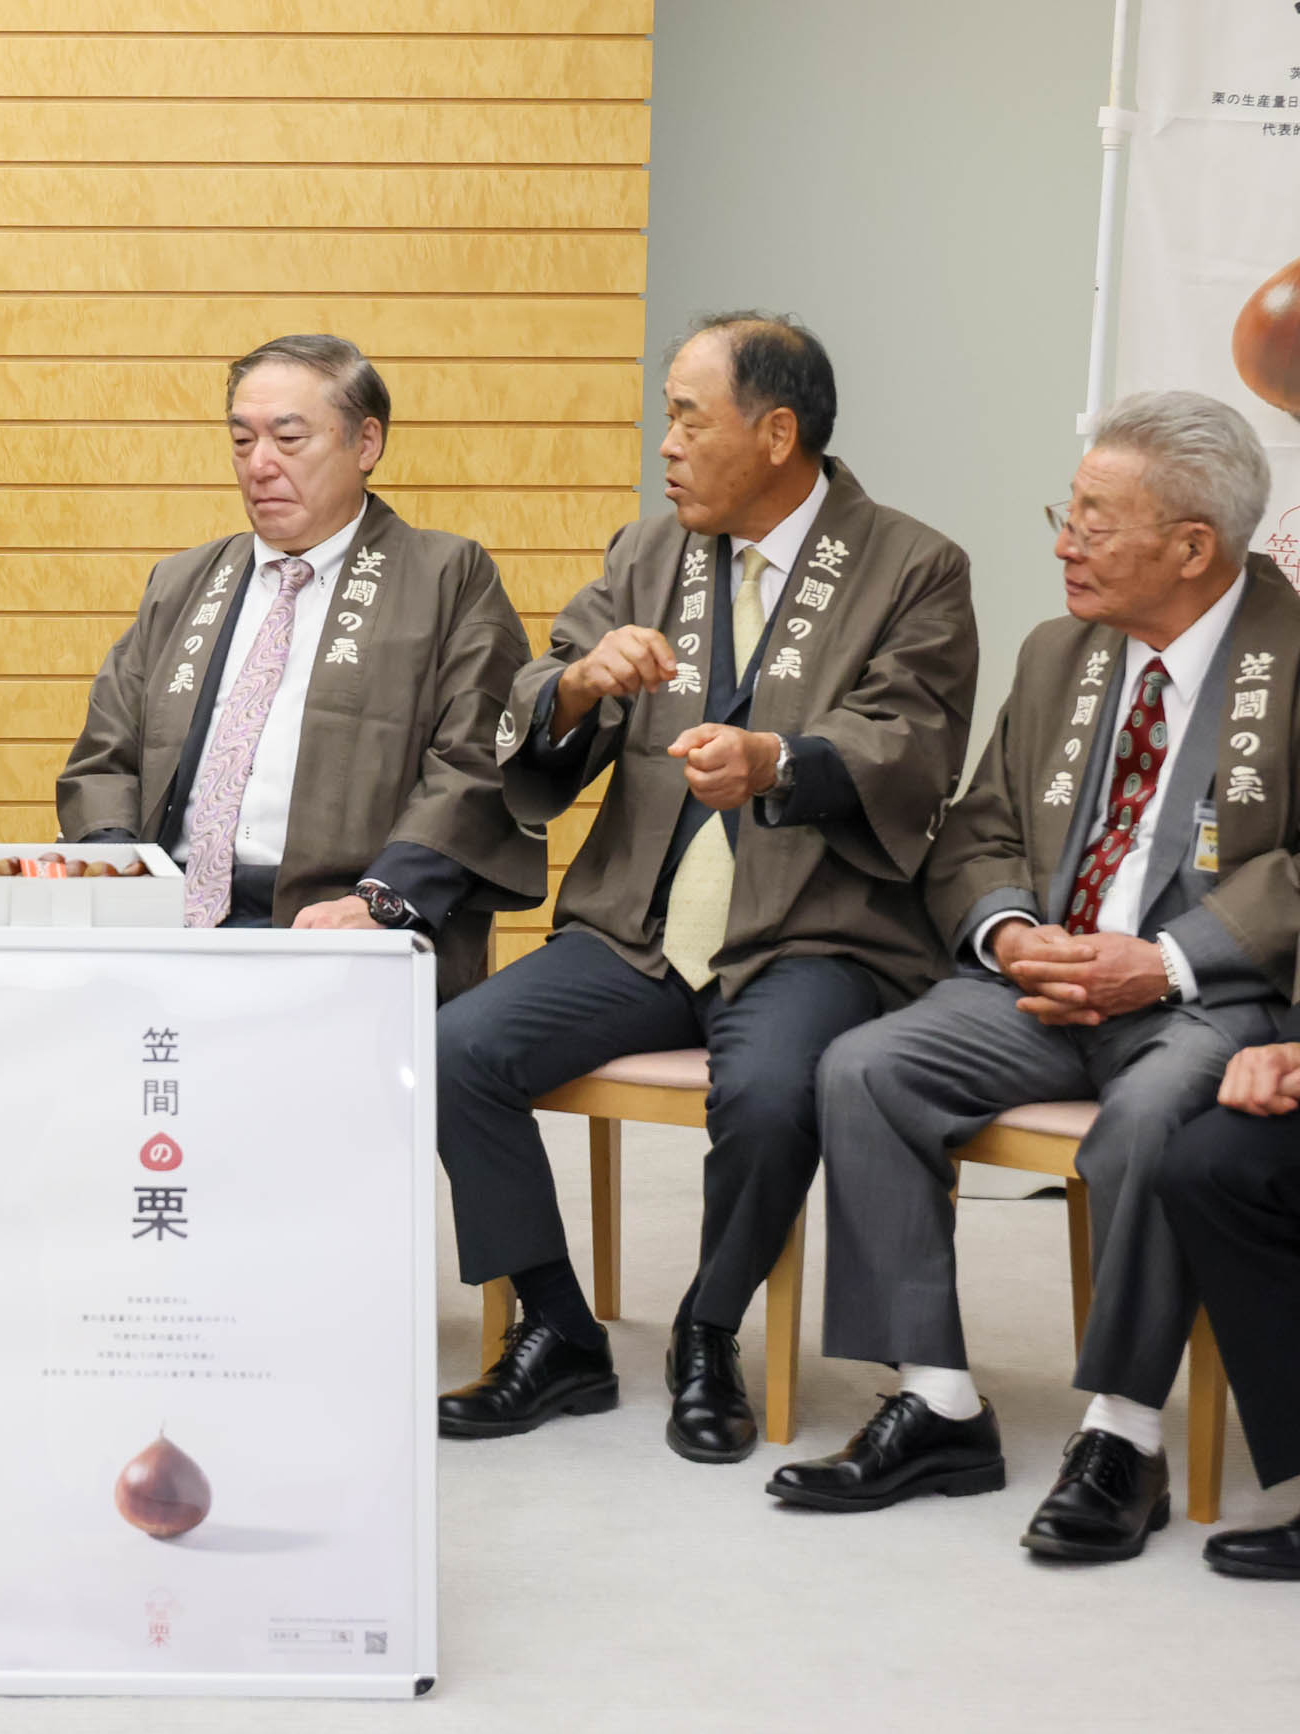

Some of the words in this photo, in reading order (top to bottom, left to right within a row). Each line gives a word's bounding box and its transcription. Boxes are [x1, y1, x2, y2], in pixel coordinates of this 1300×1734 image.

[167, 564, 235, 695] 笠間の栗
[323, 545, 387, 665] 笠間の栗
[666, 548, 709, 696] 笠間の栗
[766, 534, 850, 680] 笠間の栗
[1043, 650, 1110, 806] 笠間の栗
[1226, 652, 1275, 804] 笠間の栗
[132, 1027, 188, 1241] 笠間の栗
